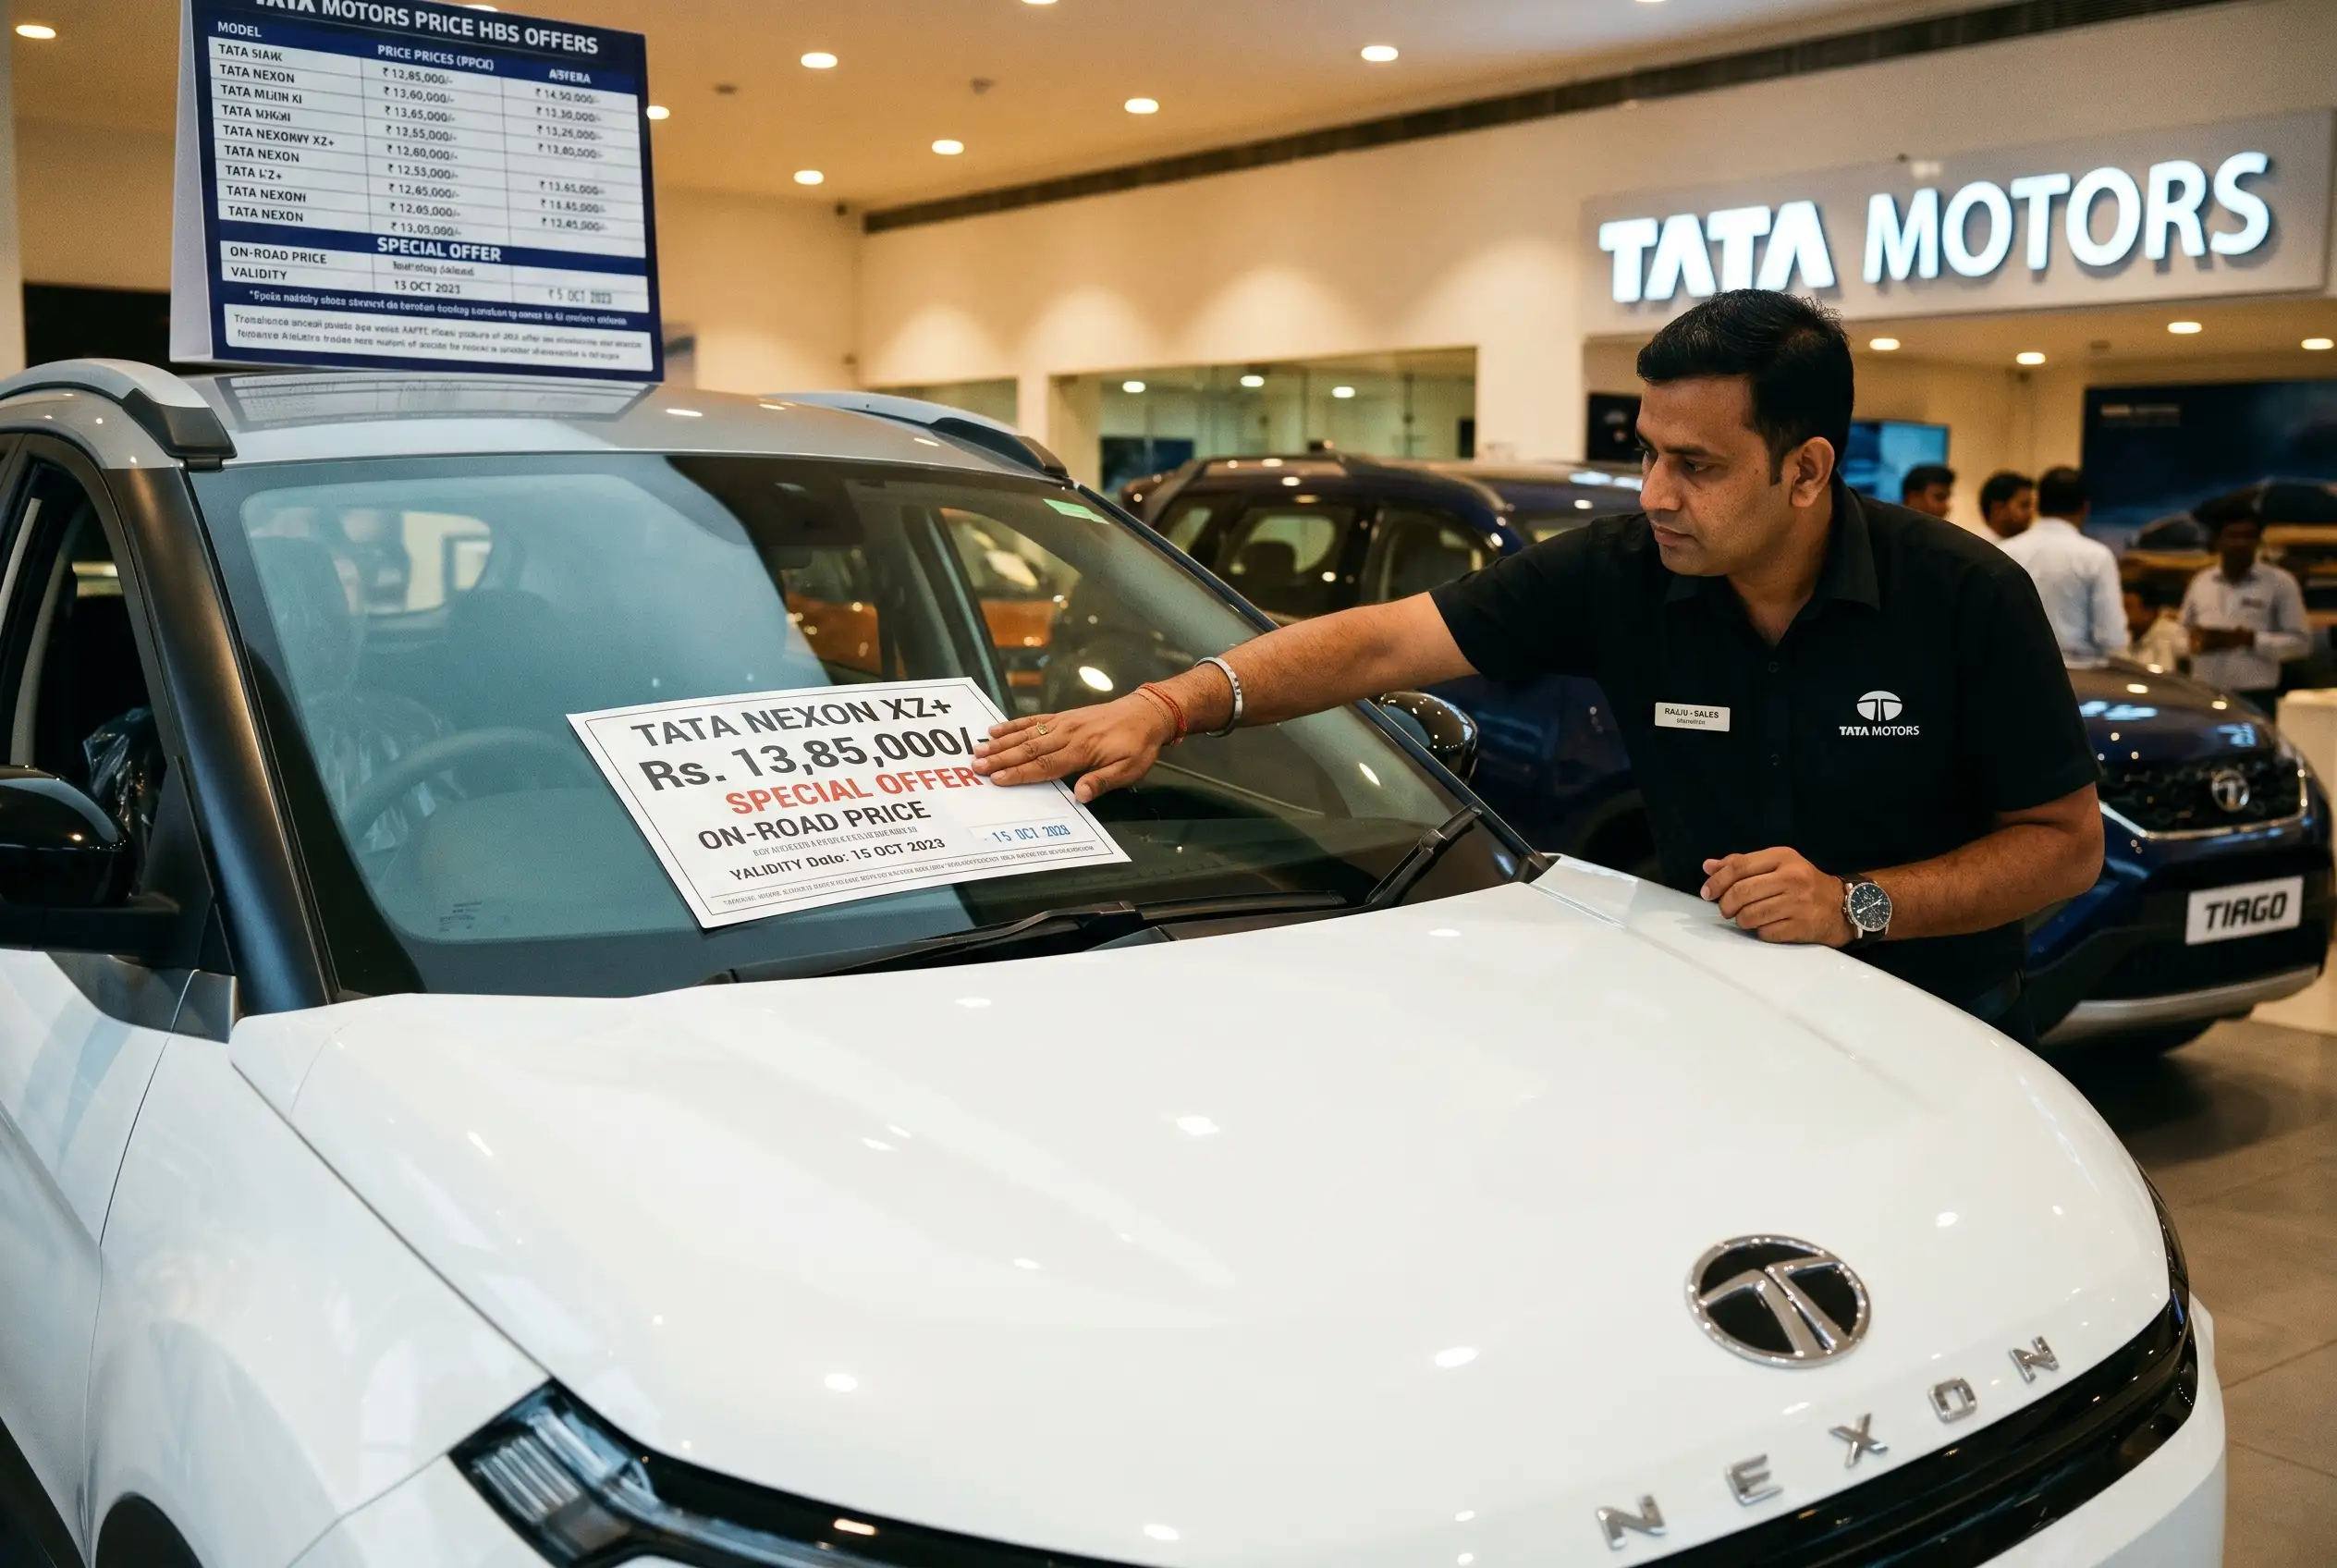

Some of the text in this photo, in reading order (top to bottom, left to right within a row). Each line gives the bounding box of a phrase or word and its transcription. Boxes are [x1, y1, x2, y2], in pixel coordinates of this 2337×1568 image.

[217, 20, 262, 38] MODEL
[322, 0, 410, 27] MOTORS
[416, 11, 474, 37] PRICE
[480, 20, 520, 43] HBS
[524, 28, 599, 55] OFFERS
[218, 43, 249, 58] TATA
[378, 44, 411, 60] PRICE
[414, 50, 454, 66] PRICES
[220, 64, 295, 84] TATA NEXON
[221, 84, 251, 98] TATA
[222, 104, 251, 118] TATA
[223, 125, 252, 138] TATA
[225, 144, 300, 163] TATA NEXON
[226, 165, 255, 178] TATA
[226, 185, 256, 199] TATA
[228, 205, 303, 223] TATA NEXON
[1598, 151, 2271, 303] TATA MOTORS
[230, 246, 327, 264] ON-ROAD PRICE
[377, 237, 502, 263] SPECIAL OFFER
[231, 266, 288, 280] VALIDITY
[410, 281, 432, 292] OCT
[630, 697, 952, 747] TATA NEXON XZ+
[1695, 710, 1719, 718] SALES
[1839, 725, 1920, 737] TATA MOTORS
[639, 727, 989, 791] Rs. 13,85,000/-
[726, 766, 985, 815] SPECIAL OFFER
[698, 813, 839, 850] ON-ROAD
[842, 800, 932, 827] PRICE
[993, 831, 1011, 843] 15
[1016, 827, 1040, 839] OCT
[850, 847, 872, 861] 15
[874, 843, 904, 856] OCT
[907, 838, 946, 852] 2023
[2206, 891, 2287, 931] TIAGO
[1596, 1335, 2060, 1550] NEXON
